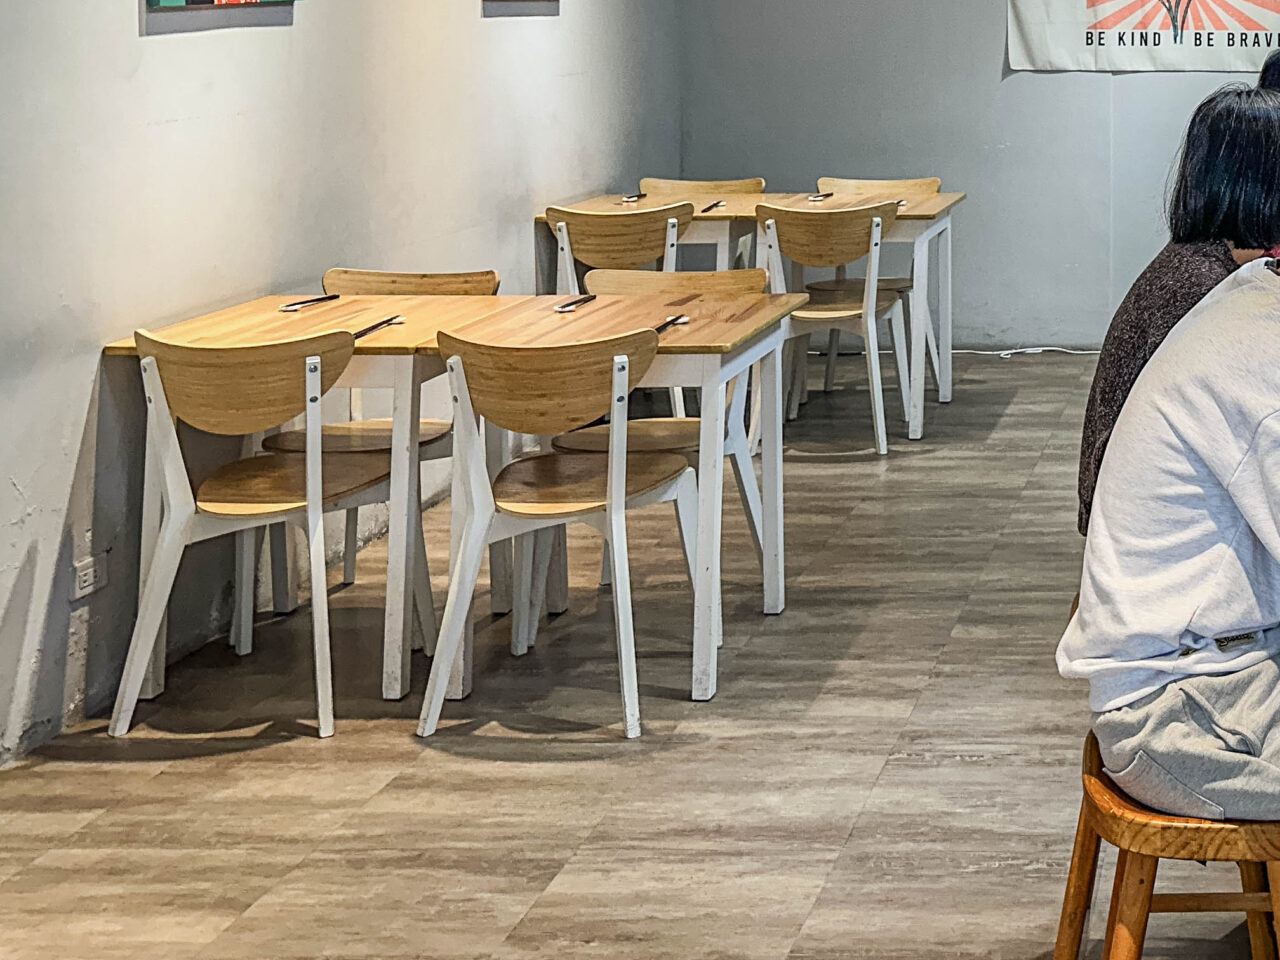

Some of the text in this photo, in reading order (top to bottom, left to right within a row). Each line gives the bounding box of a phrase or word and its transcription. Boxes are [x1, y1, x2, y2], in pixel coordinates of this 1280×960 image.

[1085, 31, 1106, 47] BE
[1118, 31, 1162, 47] KIND
[1194, 32, 1215, 47] BE
